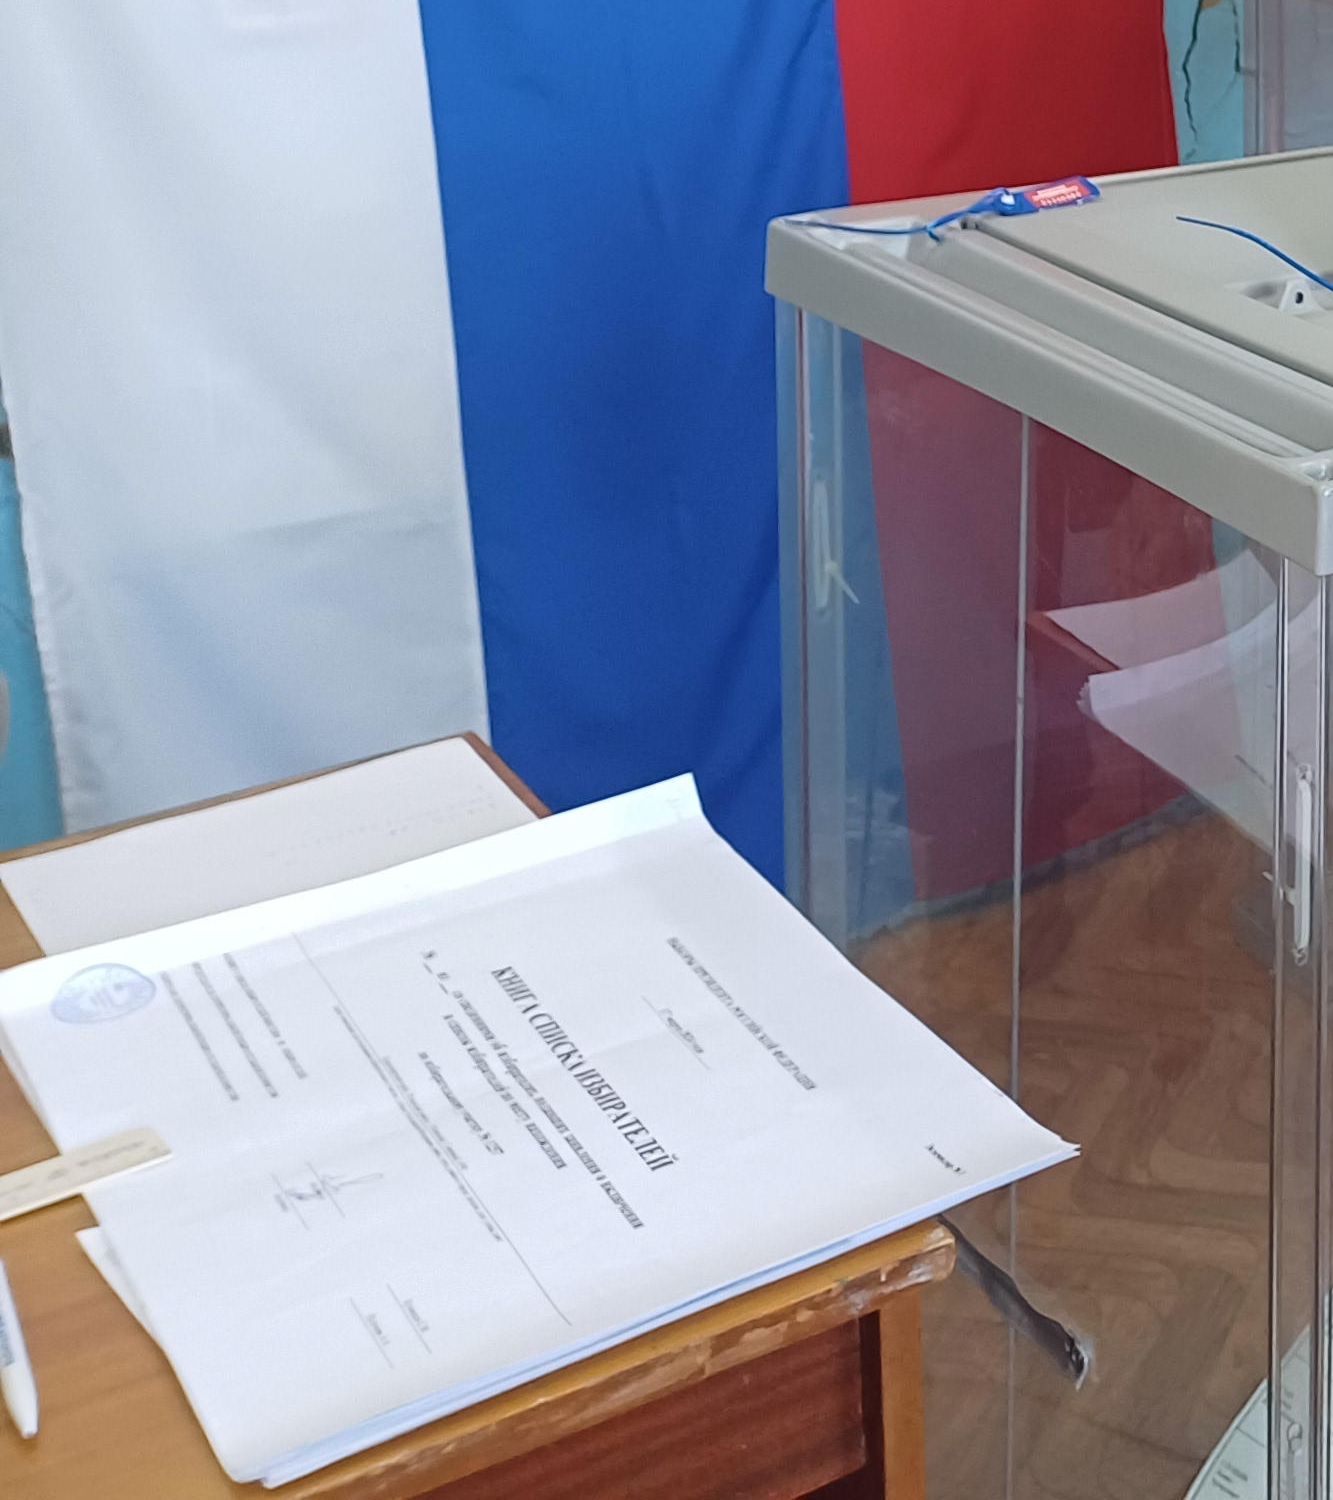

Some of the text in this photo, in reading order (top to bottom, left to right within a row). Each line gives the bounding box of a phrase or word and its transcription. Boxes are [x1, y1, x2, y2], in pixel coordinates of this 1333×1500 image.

[490, 965, 541, 1015] КНИГА
[528, 1011, 587, 1072] СПИСКА
[573, 1067, 681, 1172] ИЗБИРАТЕЛЕЙ
